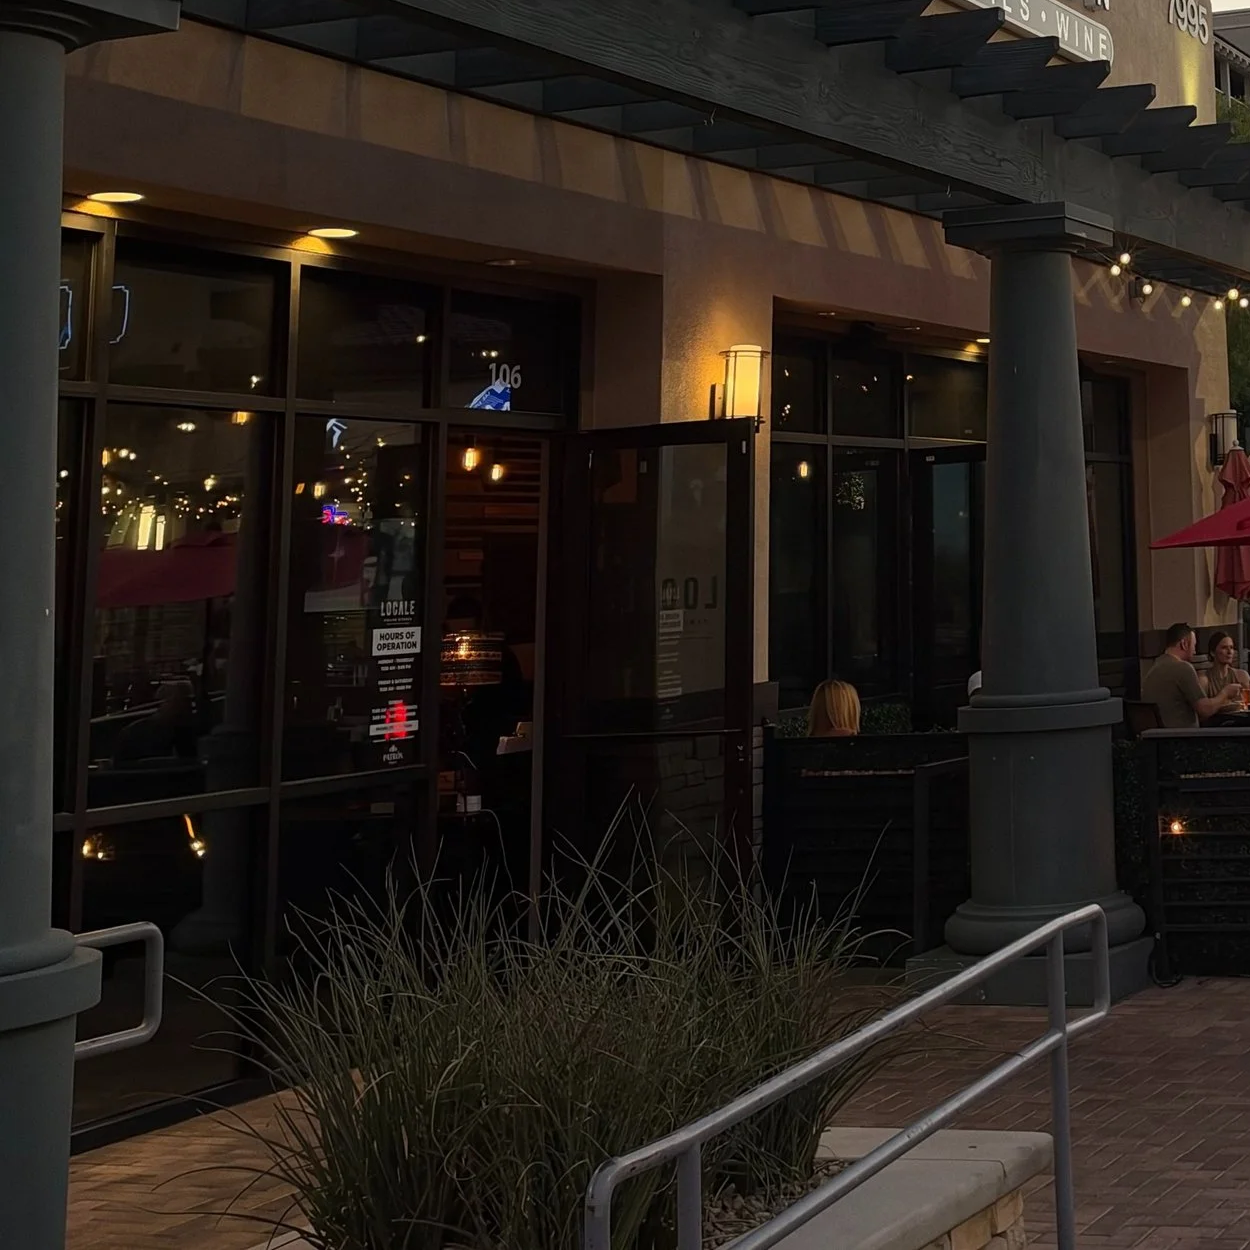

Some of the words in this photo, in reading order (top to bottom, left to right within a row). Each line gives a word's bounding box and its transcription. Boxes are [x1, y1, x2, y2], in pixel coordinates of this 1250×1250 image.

[1055, 10, 1107, 60] WINE
[488, 362, 522, 389] 106
[379, 600, 417, 617] LOCALE
[379, 631, 404, 641] HOURS
[405, 631, 416, 640] OF
[376, 641, 417, 651] OPERATION
